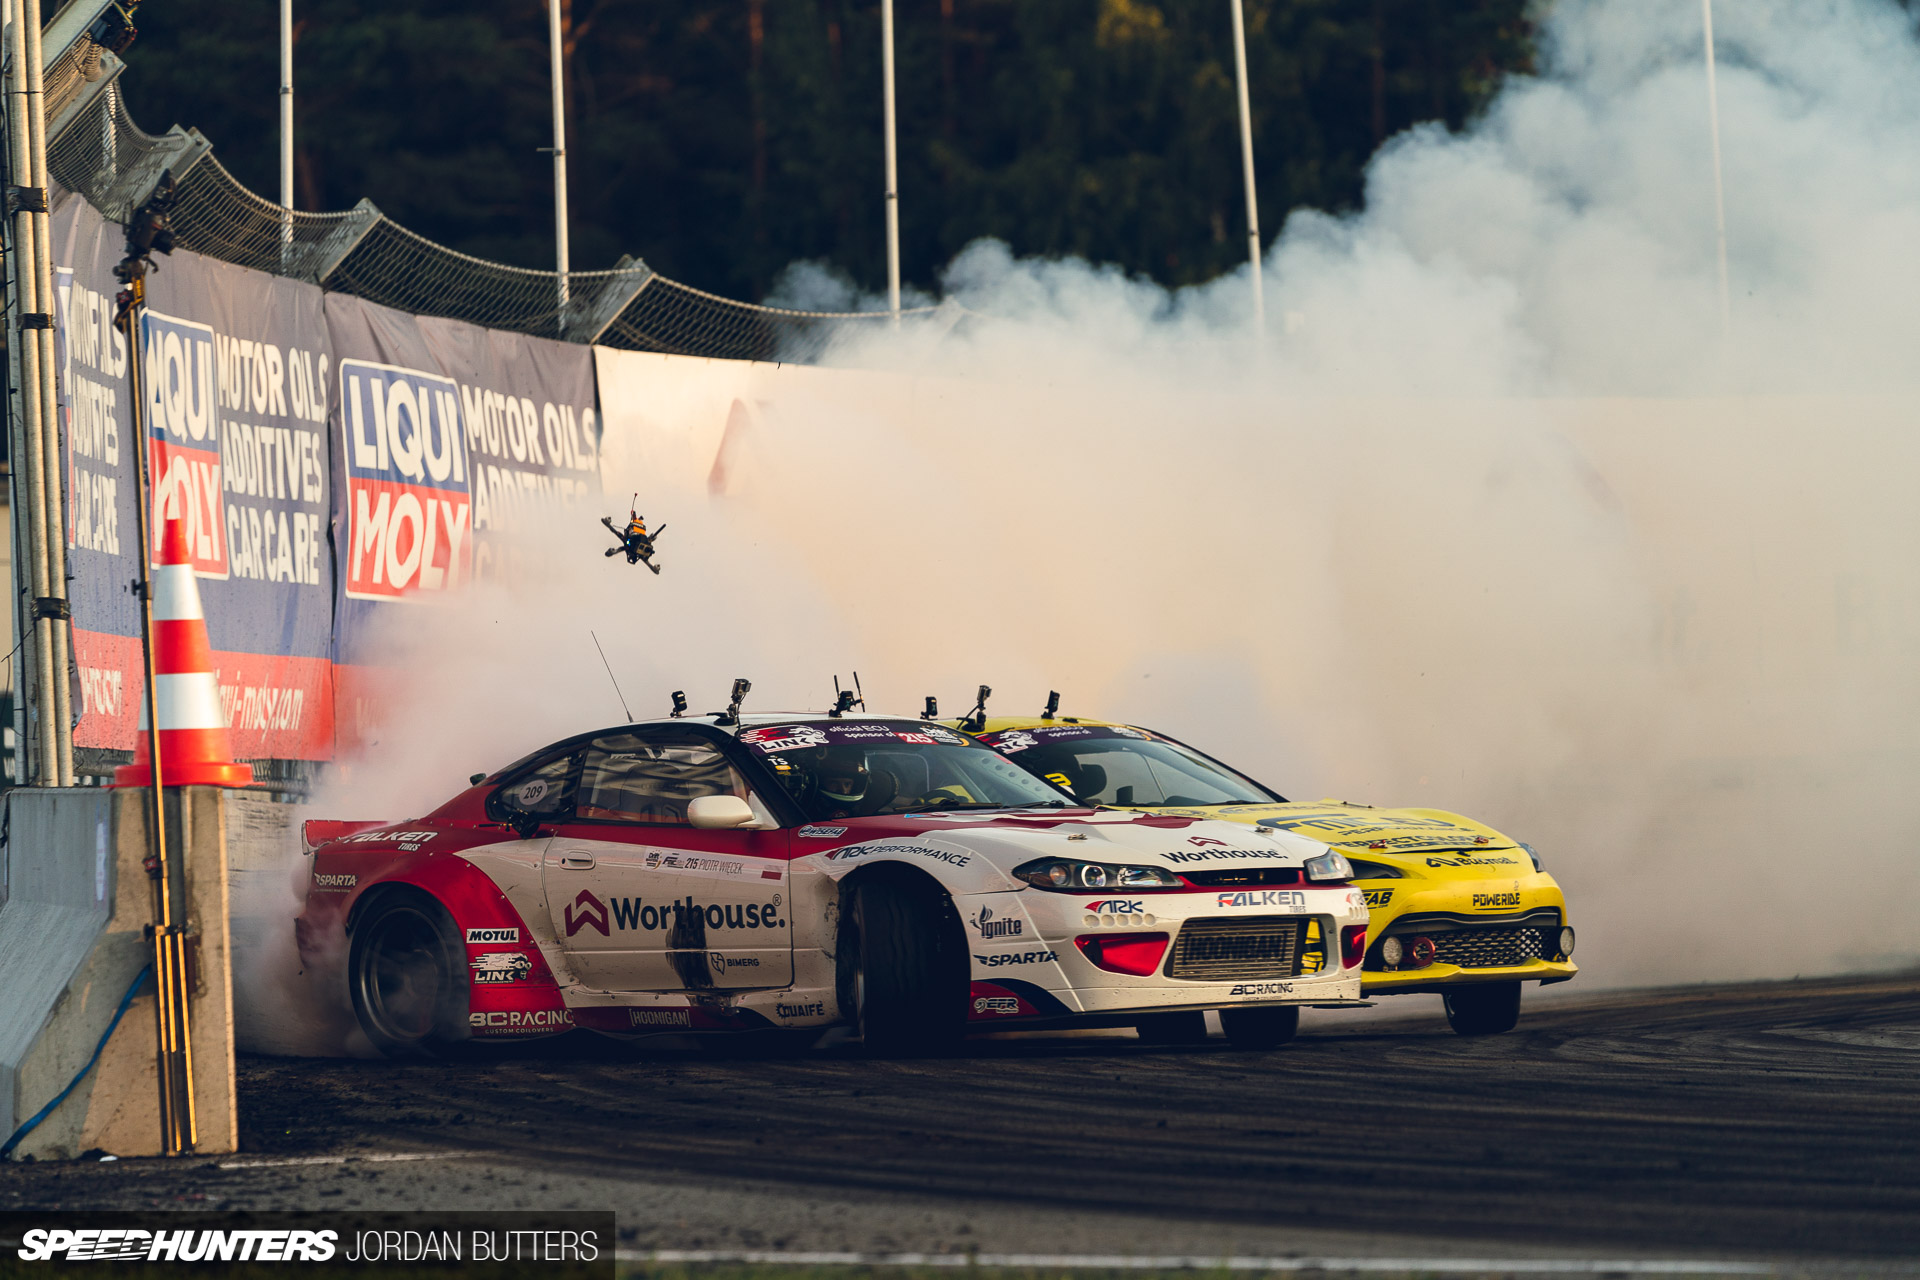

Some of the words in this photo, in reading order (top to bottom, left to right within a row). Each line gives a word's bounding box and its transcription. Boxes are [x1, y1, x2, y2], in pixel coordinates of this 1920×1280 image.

[216, 332, 287, 417] MOTOR
[288, 347, 328, 424] OILS
[348, 375, 464, 483] LIQUI
[461, 384, 545, 466] MOTOR
[543, 402, 598, 473] OILS
[222, 419, 322, 504] ADDITIVES
[227, 504, 264, 579] CAR
[264, 509, 320, 585] CARE
[352, 489, 469, 591] MOLY
[759, 737, 807, 751] LINK
[898, 733, 934, 743] 215
[523, 785, 543, 799] 209
[398, 843, 421, 851] TIRES
[872, 845, 971, 867] PERFORMANCE
[685, 857, 700, 869] 215
[699, 859, 719, 871] PIOTR
[319, 874, 358, 886] SPARTA
[1217, 891, 1305, 907] FALKEN
[1472, 892, 1520, 906] POWERIDE
[468, 930, 517, 942] MOTUL
[726, 958, 760, 967] BIMERG
[988, 950, 1060, 966] SPARTA
[474, 970, 515, 981] LINK
[1257, 983, 1294, 994] RACING
[986, 998, 1019, 1009] EFR
[509, 1009, 574, 1026] RACING
